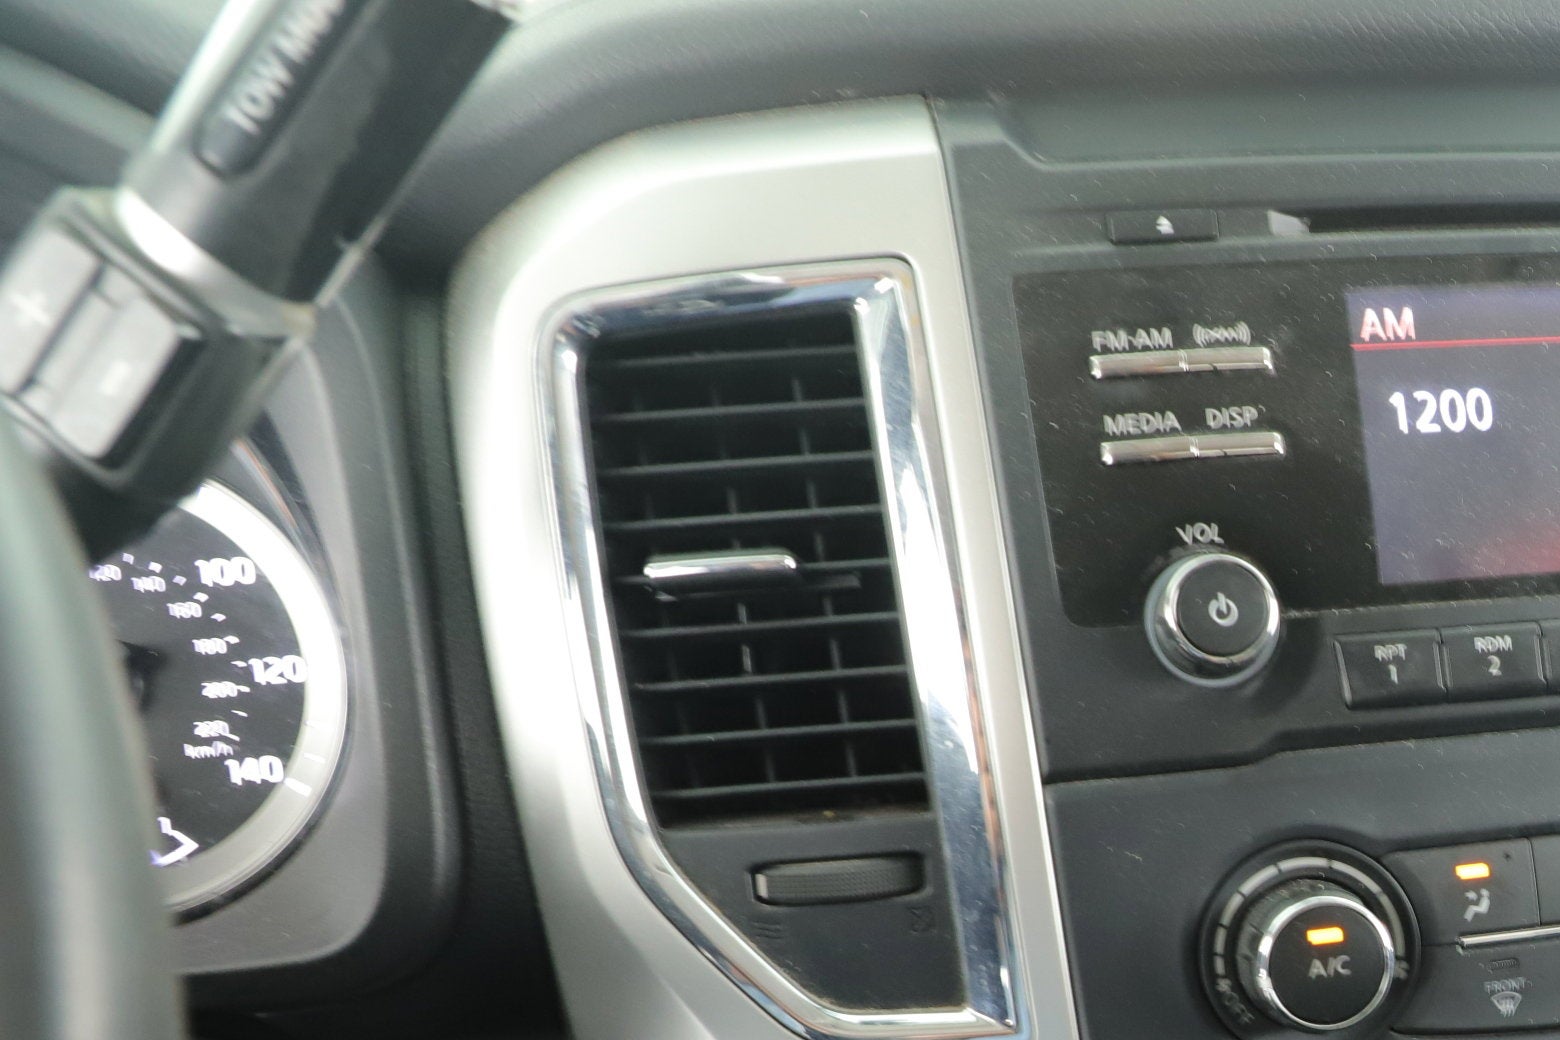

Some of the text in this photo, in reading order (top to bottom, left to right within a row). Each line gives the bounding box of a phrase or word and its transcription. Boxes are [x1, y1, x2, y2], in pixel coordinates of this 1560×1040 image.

[1360, 306, 1416, 341] AM
[1205, 406, 1258, 429] DISP
[1388, 387, 1494, 434] 1200
[1103, 411, 1182, 436] MEDIA
[1175, 522, 1225, 545] VOL
[195, 557, 256, 587] 100
[1374, 644, 1407, 661] RPT
[1474, 635, 1512, 654] RDM
[248, 655, 307, 685] 120
[1388, 664, 1399, 684] 1
[1487, 655, 1502, 676] 2
[224, 755, 284, 785] 140
[1308, 955, 1352, 979] A/C
[1483, 977, 1526, 994] FRONT
